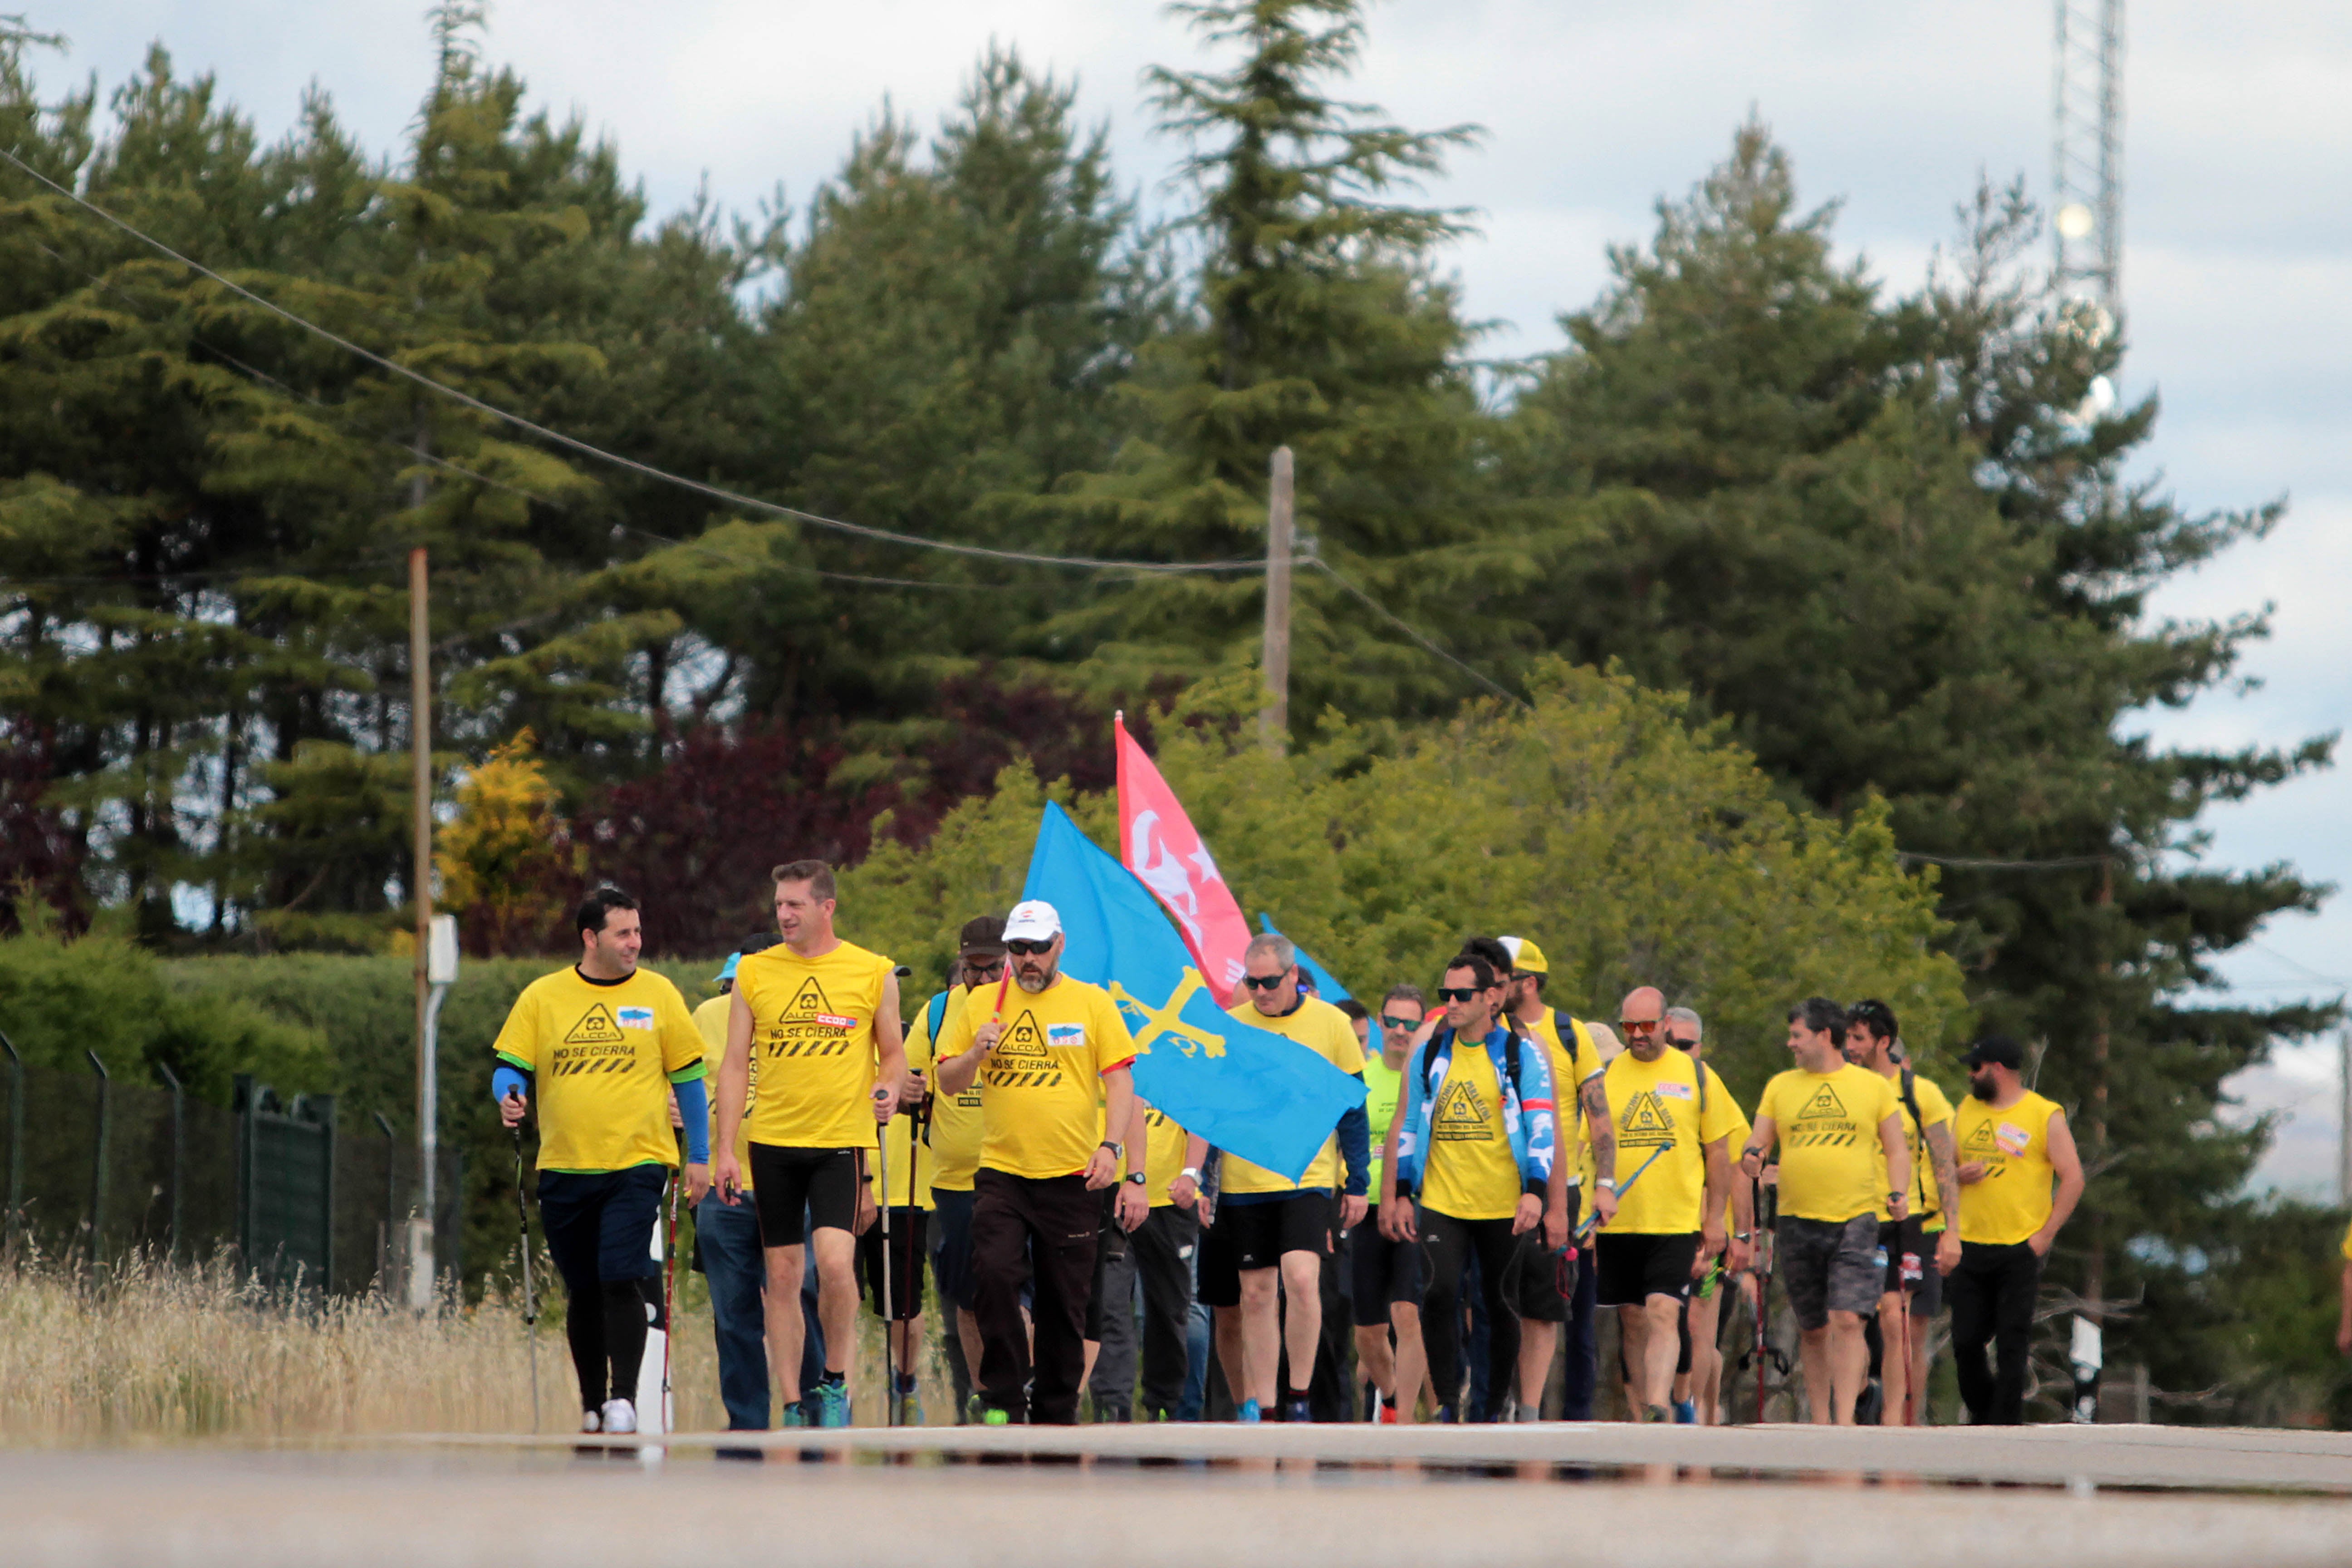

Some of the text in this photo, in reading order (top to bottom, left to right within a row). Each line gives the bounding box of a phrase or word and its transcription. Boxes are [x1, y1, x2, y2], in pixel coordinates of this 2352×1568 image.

[770, 1026, 847, 1039] NO SE CIERRA
[553, 1045, 635, 1059] NO SE CIERRA
[1001, 1044, 1042, 1053] ALCOA
[990, 1058, 1059, 1070] NO SE CIERRA
